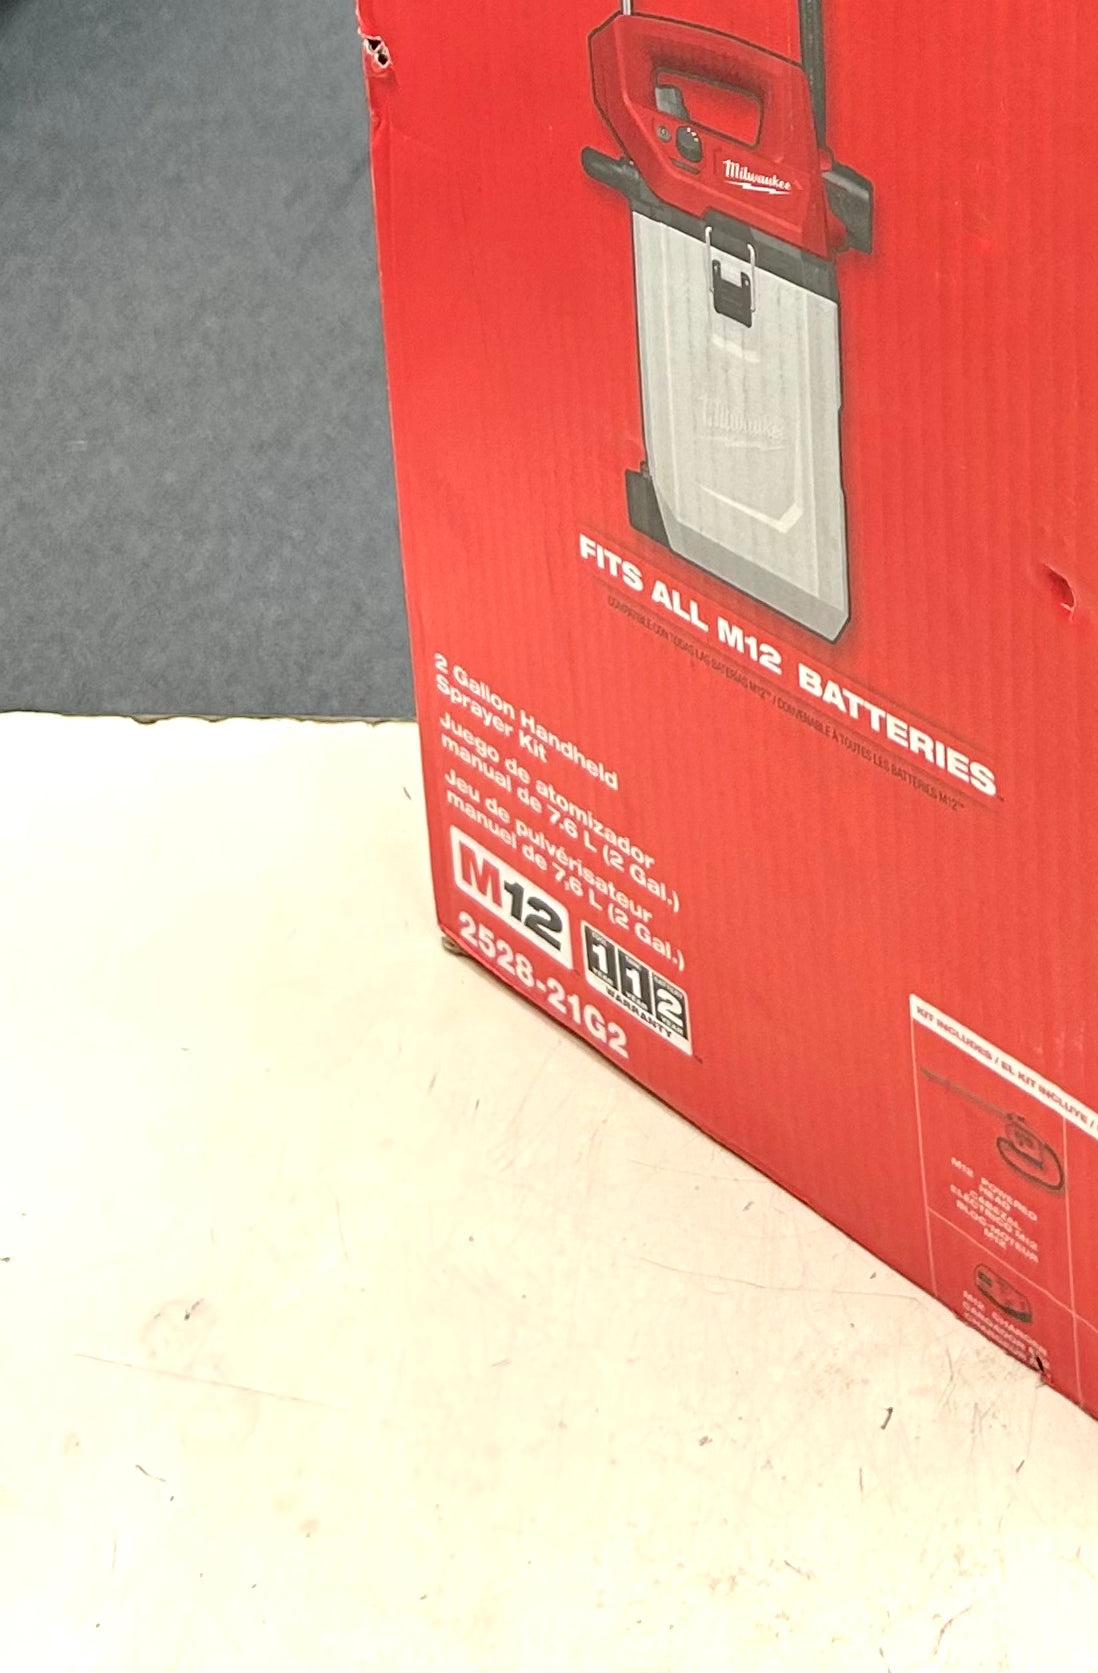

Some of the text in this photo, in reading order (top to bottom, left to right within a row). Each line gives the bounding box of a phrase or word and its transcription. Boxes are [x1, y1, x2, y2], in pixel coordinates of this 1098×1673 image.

[723, 158, 792, 191] Milwaukee
[436, 674, 548, 763] Sprayer Kit
[578, 533, 997, 797] FITS ALL M12 BATTERIES
[434, 653, 619, 791] 2 Gallon Handheld
[440, 712, 655, 869] Juego de atomizador
[441, 733, 680, 913] manual de 7.6 L (2 Gal.)
[445, 769, 653, 924] Jeu de pulvérisateur
[447, 789, 517, 849] manuel
[522, 843, 548, 871] de
[588, 888, 603, 912] L
[607, 902, 630, 931] (2
[634, 921, 686, 972] Gal.)
[458, 841, 563, 952] M12
[458, 911, 629, 1059] 2528-21G2
[591, 941, 609, 975] 1
[606, 985, 674, 1039] WARRANTY
[625, 963, 642, 1000] 1
[656, 989, 683, 1028] 2
[916, 1005, 934, 1022] KIT
[1018, 1072, 1037, 1089] KIT
